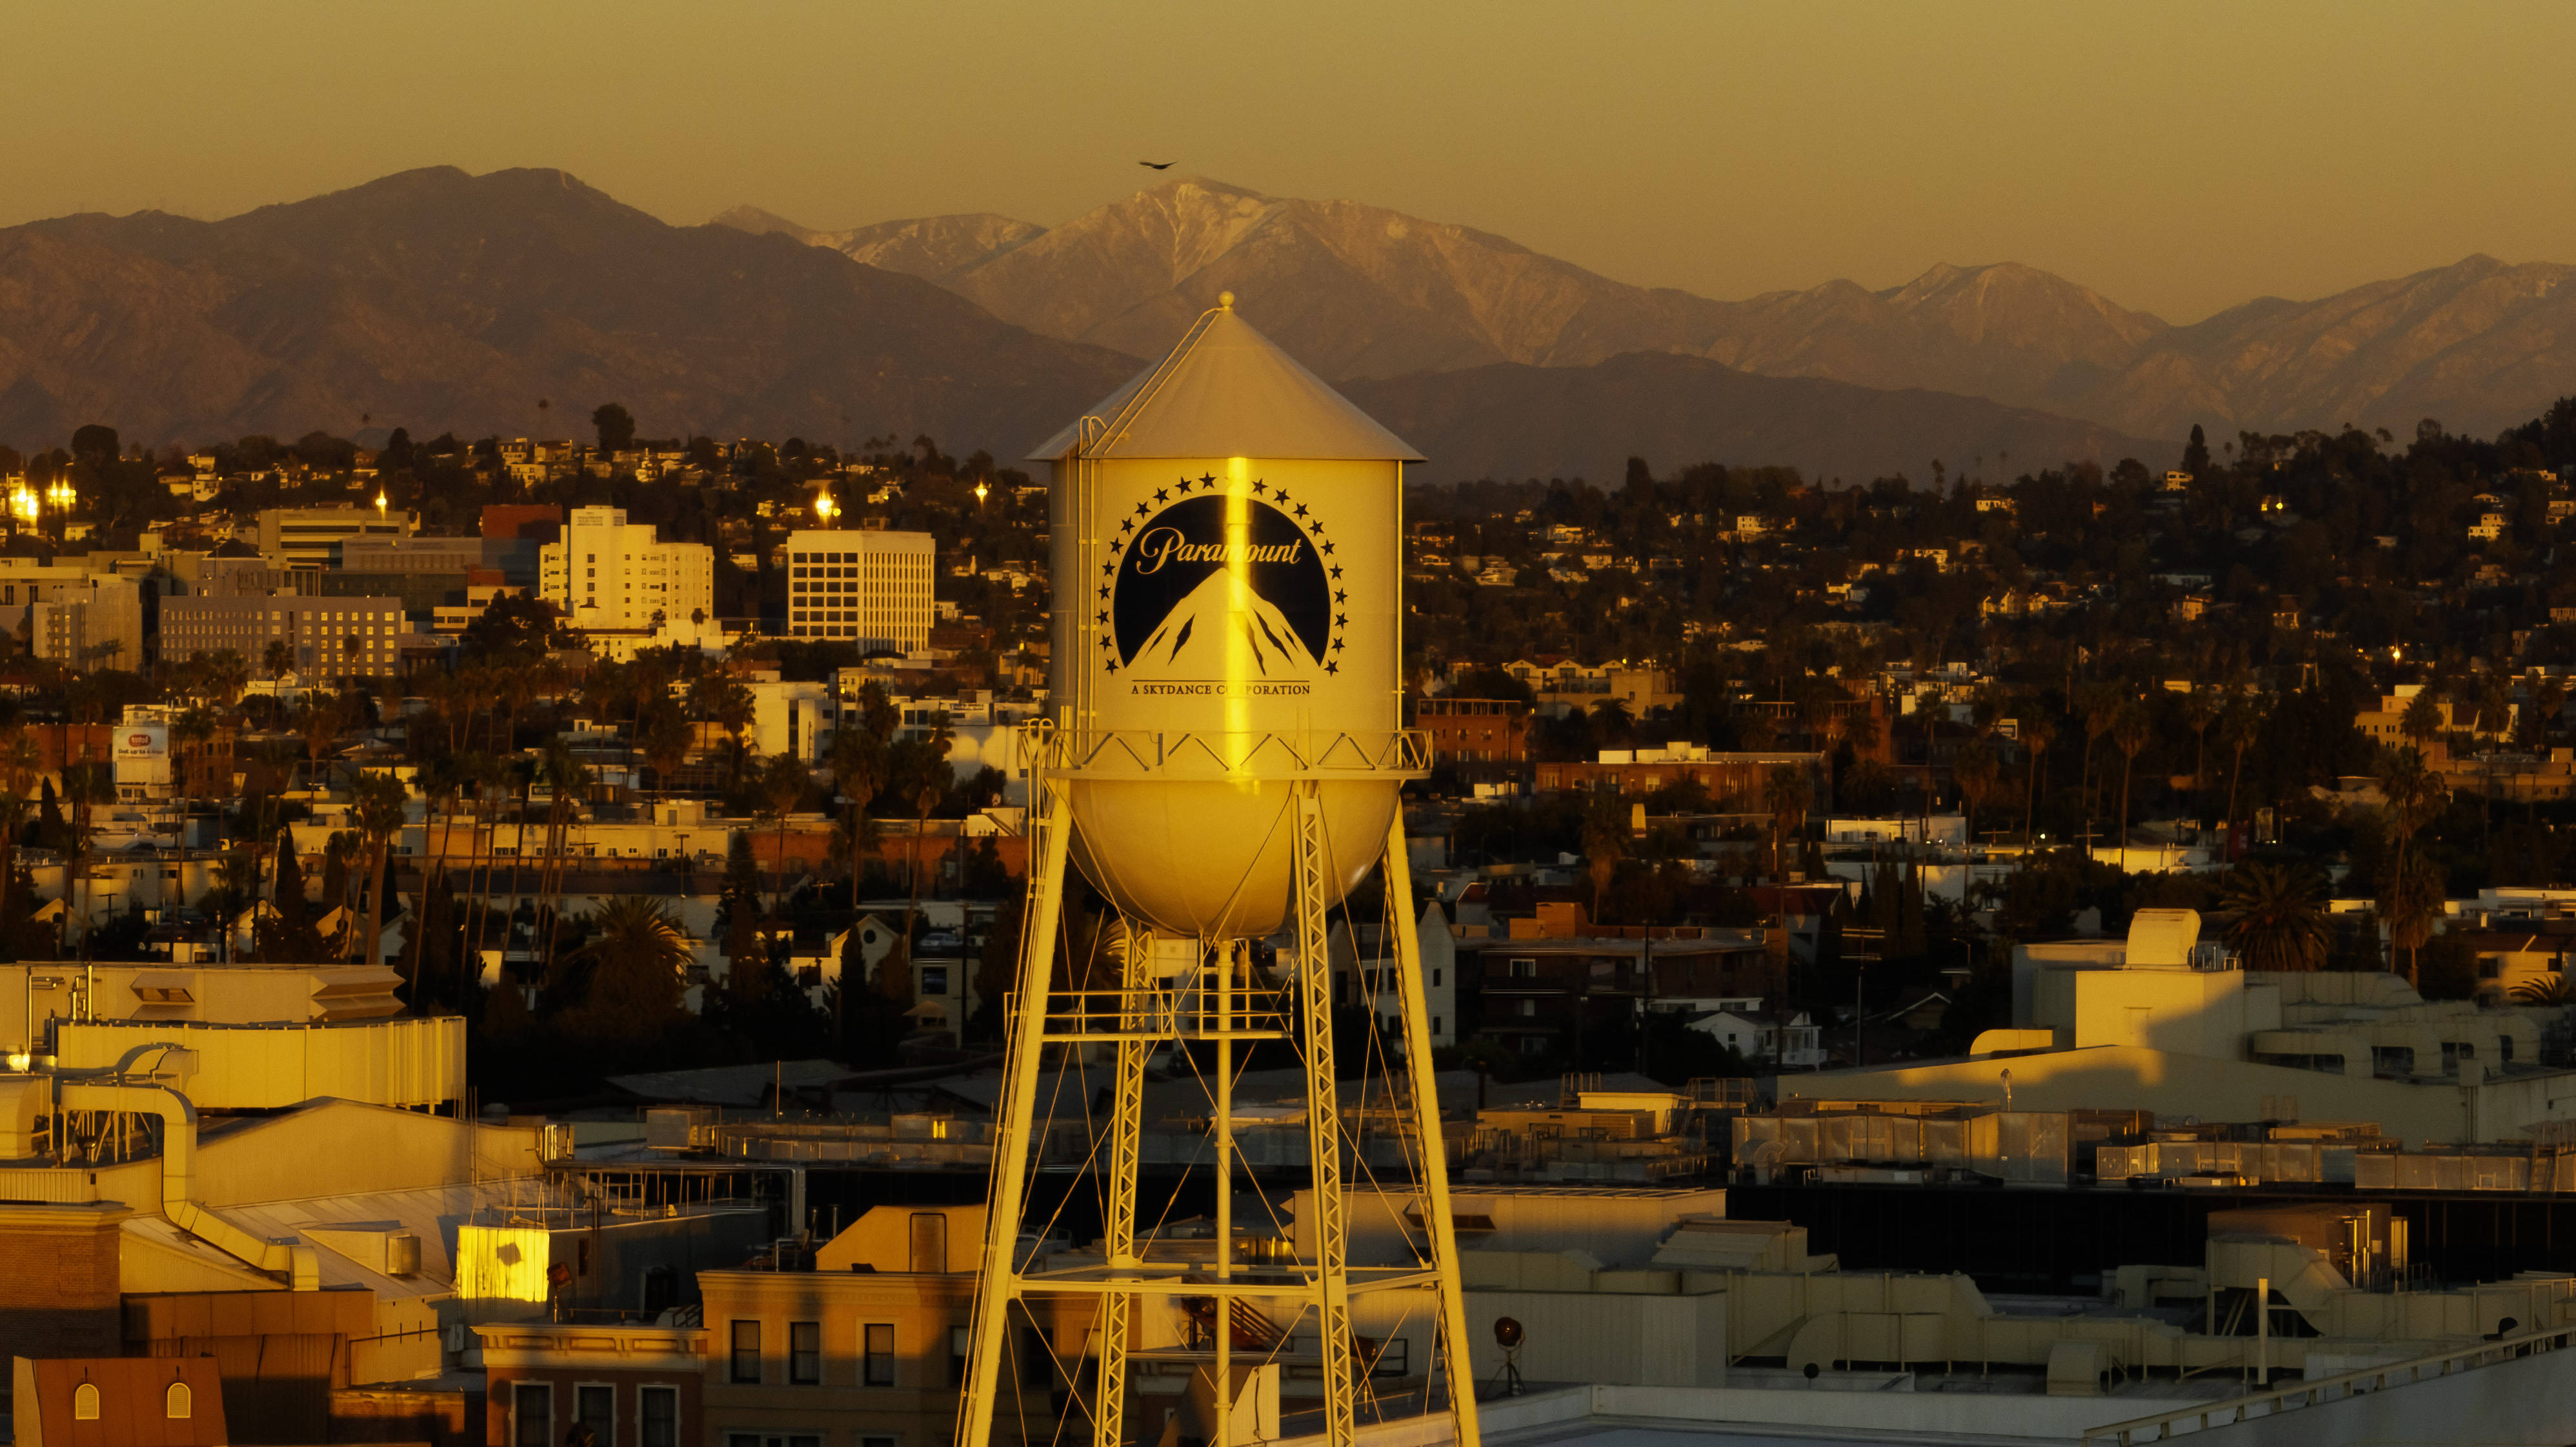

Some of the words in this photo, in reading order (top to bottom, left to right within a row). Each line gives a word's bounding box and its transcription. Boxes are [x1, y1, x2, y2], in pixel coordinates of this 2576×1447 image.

[1131, 685, 1139, 694] A
[1143, 685, 1212, 694] SKYDANCE
[1216, 685, 1311, 695] CPORATION
